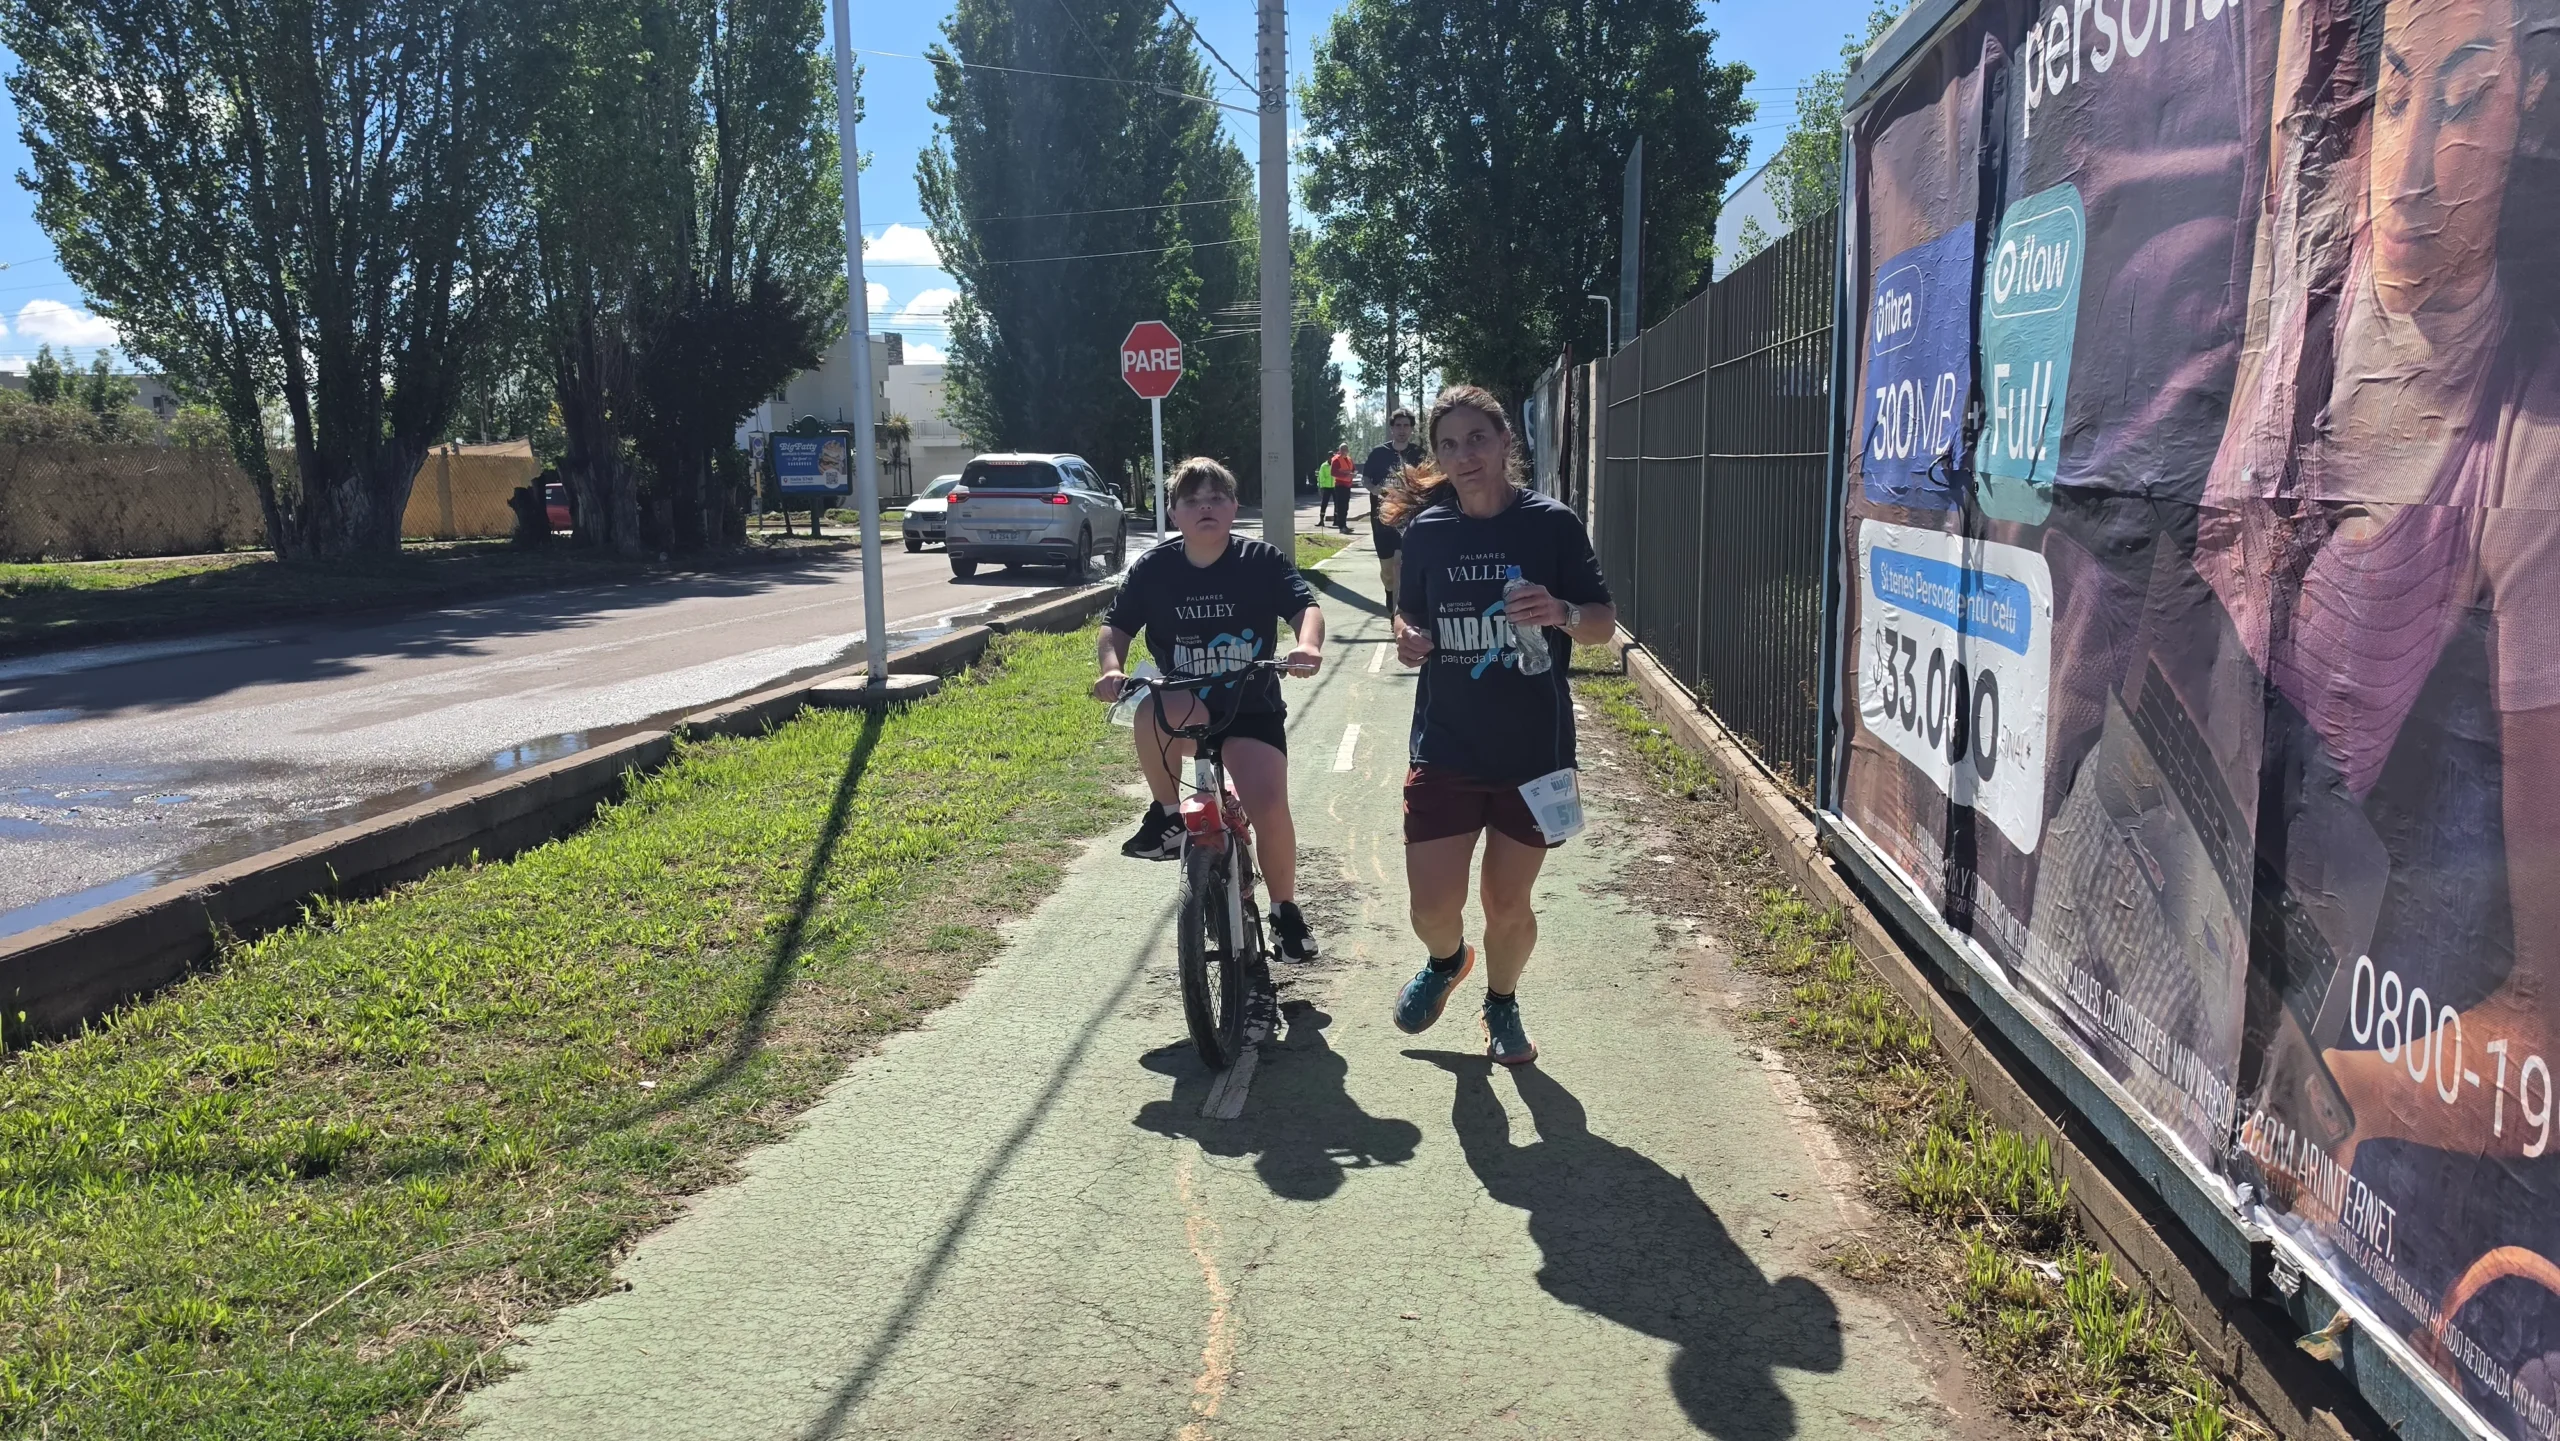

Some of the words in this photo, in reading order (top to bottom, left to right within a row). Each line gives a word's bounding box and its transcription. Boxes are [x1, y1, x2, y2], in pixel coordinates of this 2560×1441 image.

[2017, 234, 2071, 295] flow
[1884, 288, 1913, 337] fibra
[1123, 347, 1181, 373] PARE
[1873, 372, 1956, 461] 300MB
[1992, 361, 2053, 461] Full
[1446, 564, 1514, 582] VALLE
[1460, 552, 1506, 561] PALMARES
[1175, 604, 1236, 620] VALLEY
[1186, 594, 1223, 602] PALMARES
[1446, 600, 1472, 609] parroquia
[1880, 561, 1889, 590] Si
[1889, 566, 1915, 600] tenés
[1915, 571, 1956, 615] Personal
[1957, 593, 1974, 621] en
[1975, 595, 1989, 624] tu
[1991, 598, 2017, 635] celu
[1437, 615, 1516, 651] MARAT
[1460, 653, 1486, 665] toda
[1489, 652, 1498, 662] la
[2103, 989, 2156, 1062] CONSULTE
[2153, 1028, 2171, 1075] EN
[2350, 955, 2560, 1158] 0800-19
[2367, 1251, 2396, 1297] FIGURA
[2395, 1275, 2430, 1330] HUMANA
[2441, 1319, 2463, 1358] SIDO
[2463, 1337, 2510, 1402] RETOCADA
